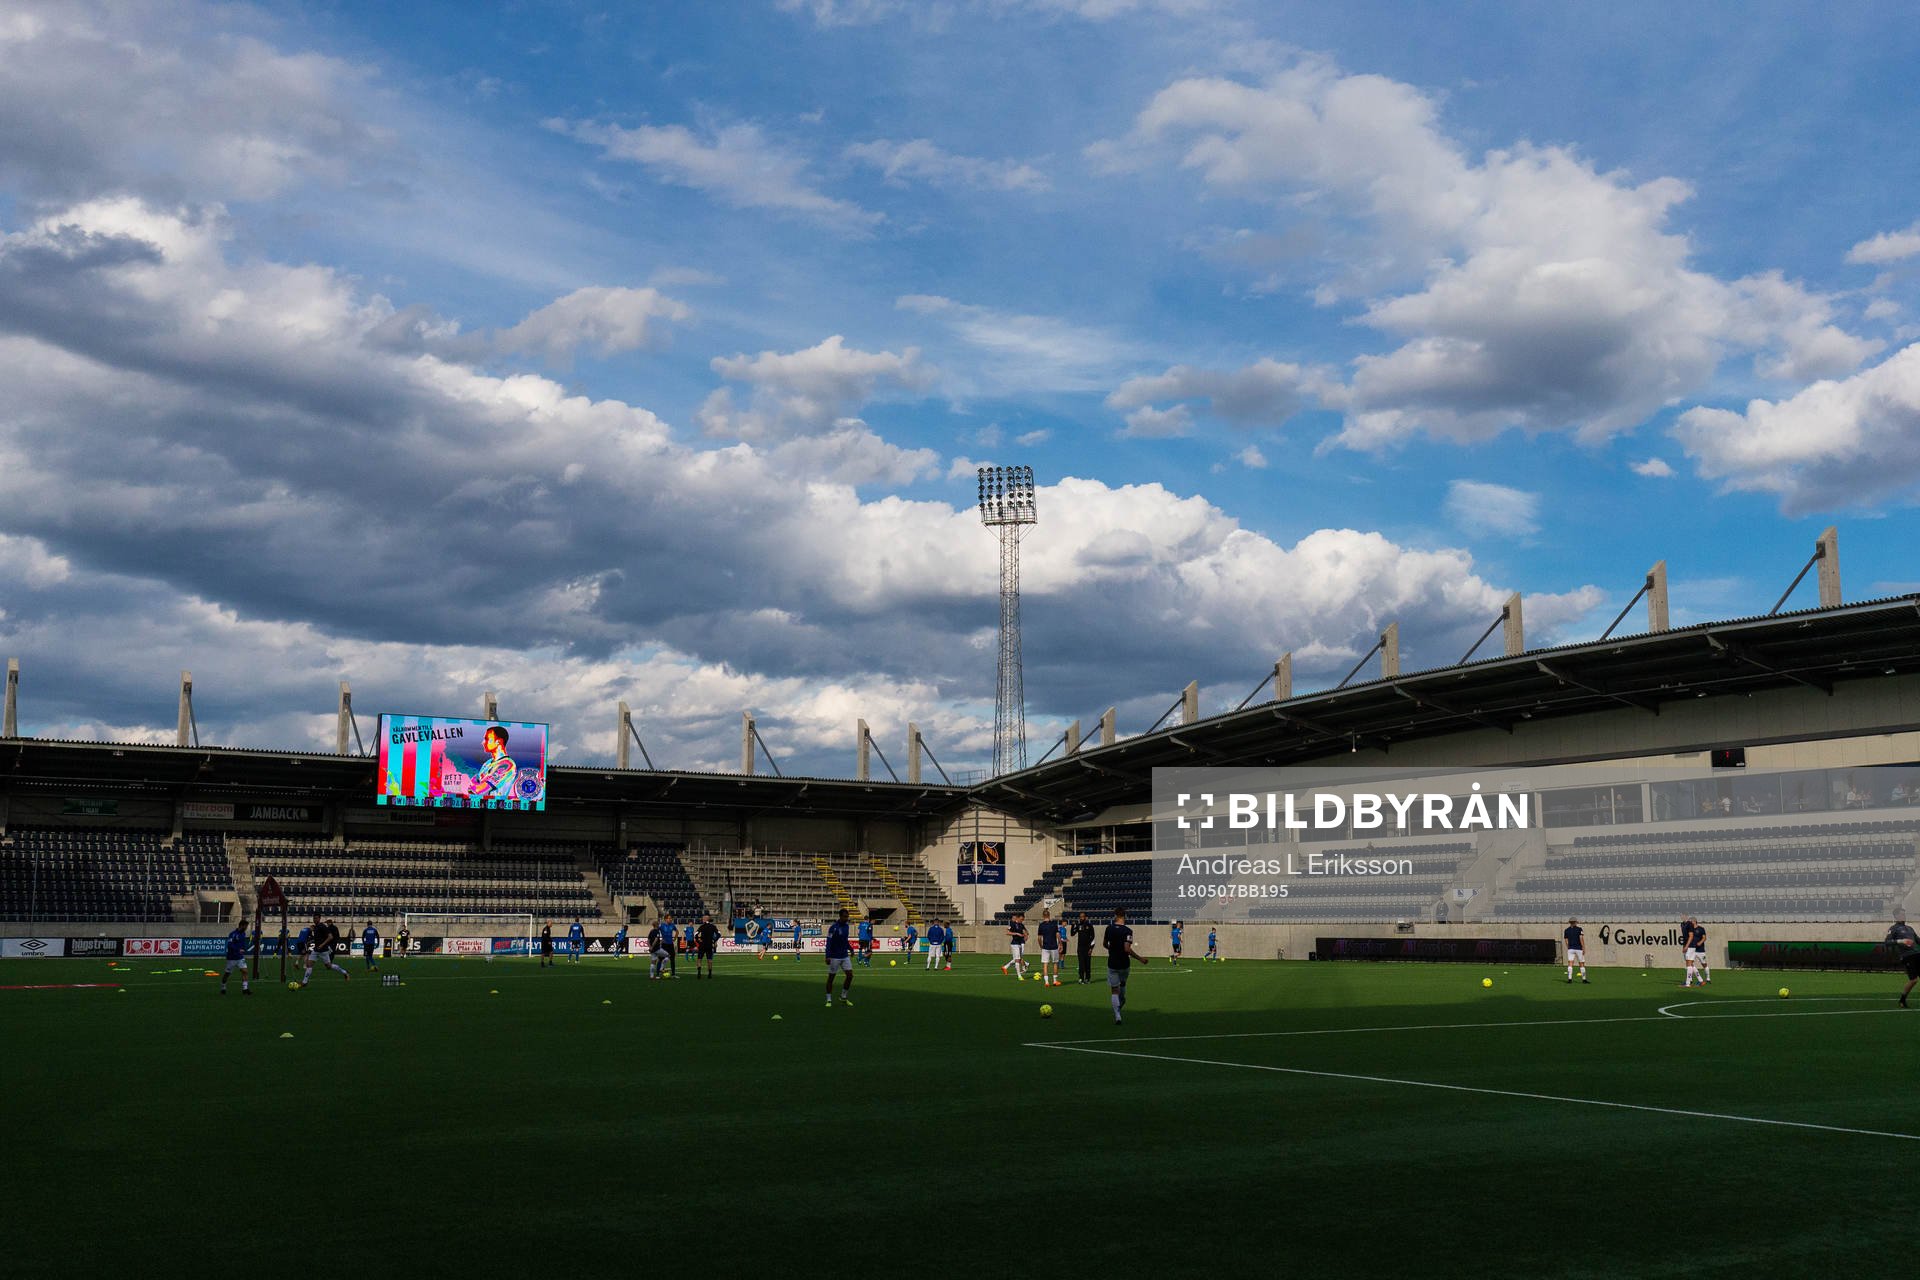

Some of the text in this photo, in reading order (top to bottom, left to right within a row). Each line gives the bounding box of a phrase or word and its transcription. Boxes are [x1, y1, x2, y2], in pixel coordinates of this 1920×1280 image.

[392, 727, 464, 744] GAVLEVALLEN
[249, 806, 300, 820] JAMBACK
[1614, 929, 1686, 946] Gavlevalle
